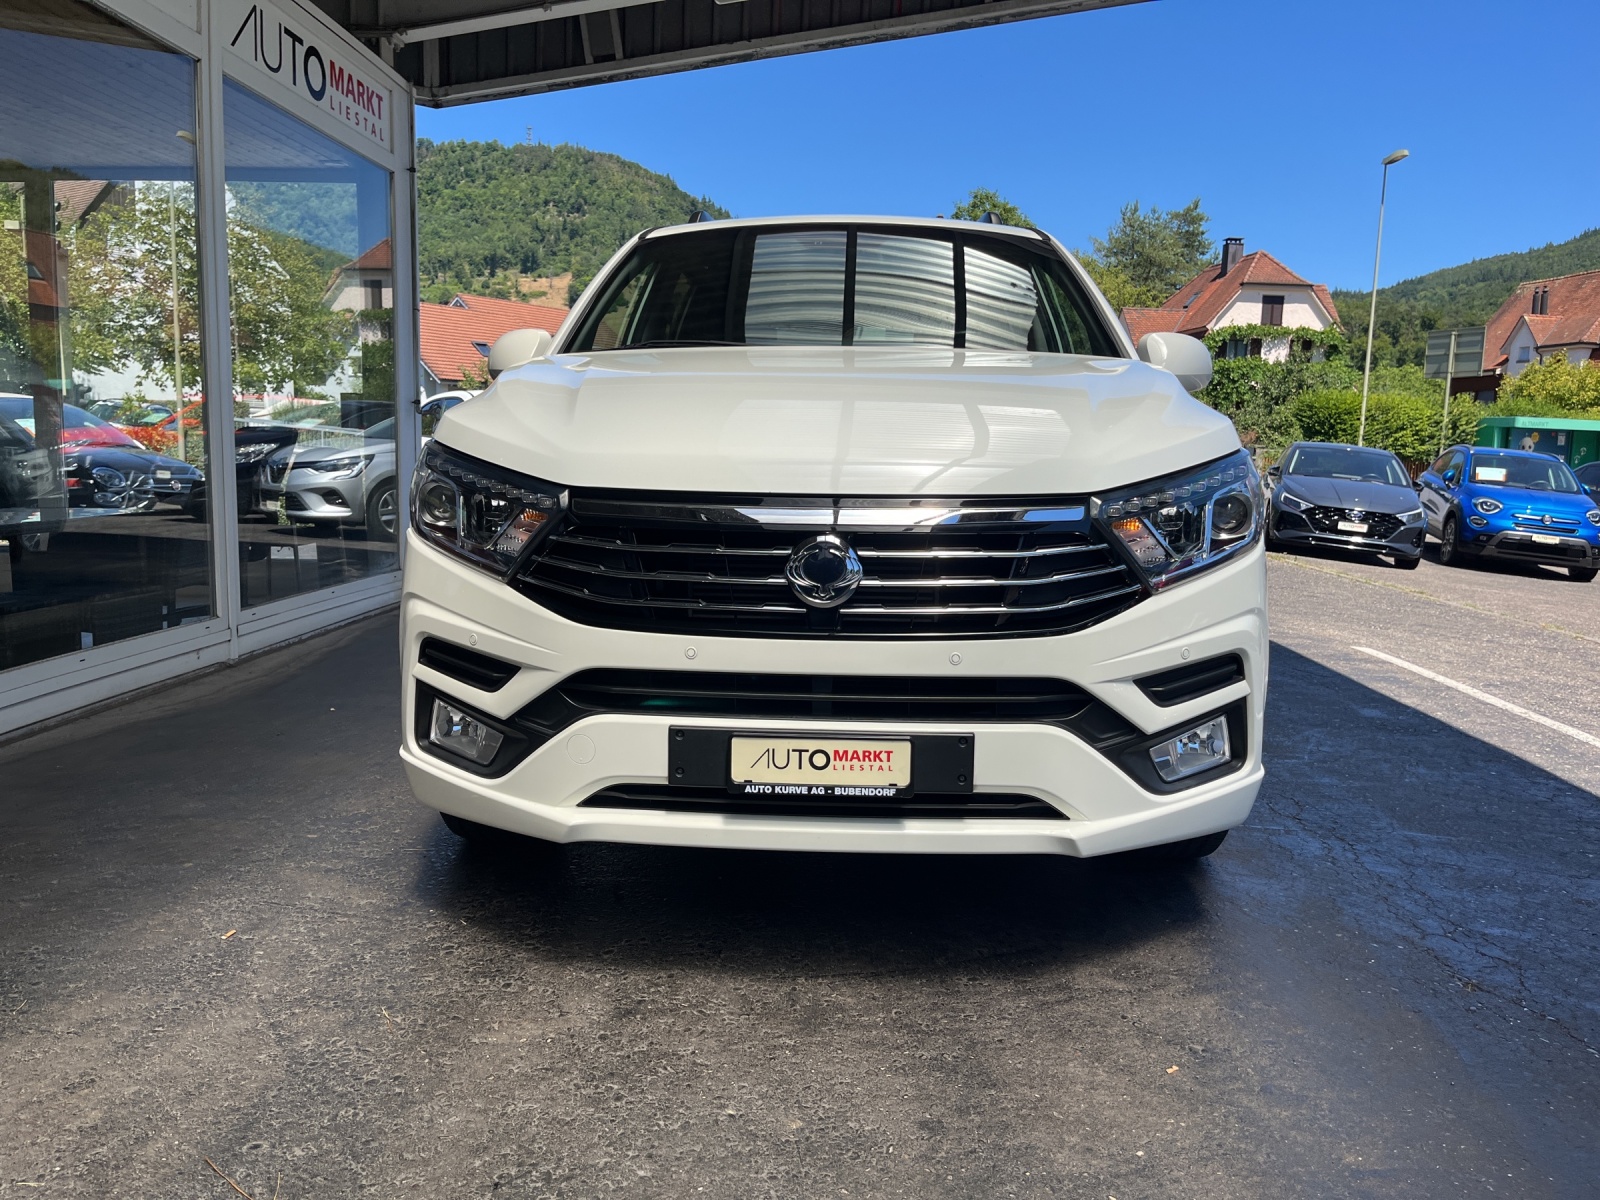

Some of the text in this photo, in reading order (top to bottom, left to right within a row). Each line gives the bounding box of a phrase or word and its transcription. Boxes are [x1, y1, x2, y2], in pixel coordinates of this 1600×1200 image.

[230, 4, 384, 120] AUTO MARKT
[329, 95, 384, 142] LIESTAL
[750, 748, 894, 771] AUTO MARKT
[832, 764, 894, 772] LIESTAL
[744, 785, 773, 794] AUTO
[774, 785, 809, 794] KURVE
[810, 786, 825, 795] AG
[834, 787, 897, 797] BUBENDORF
